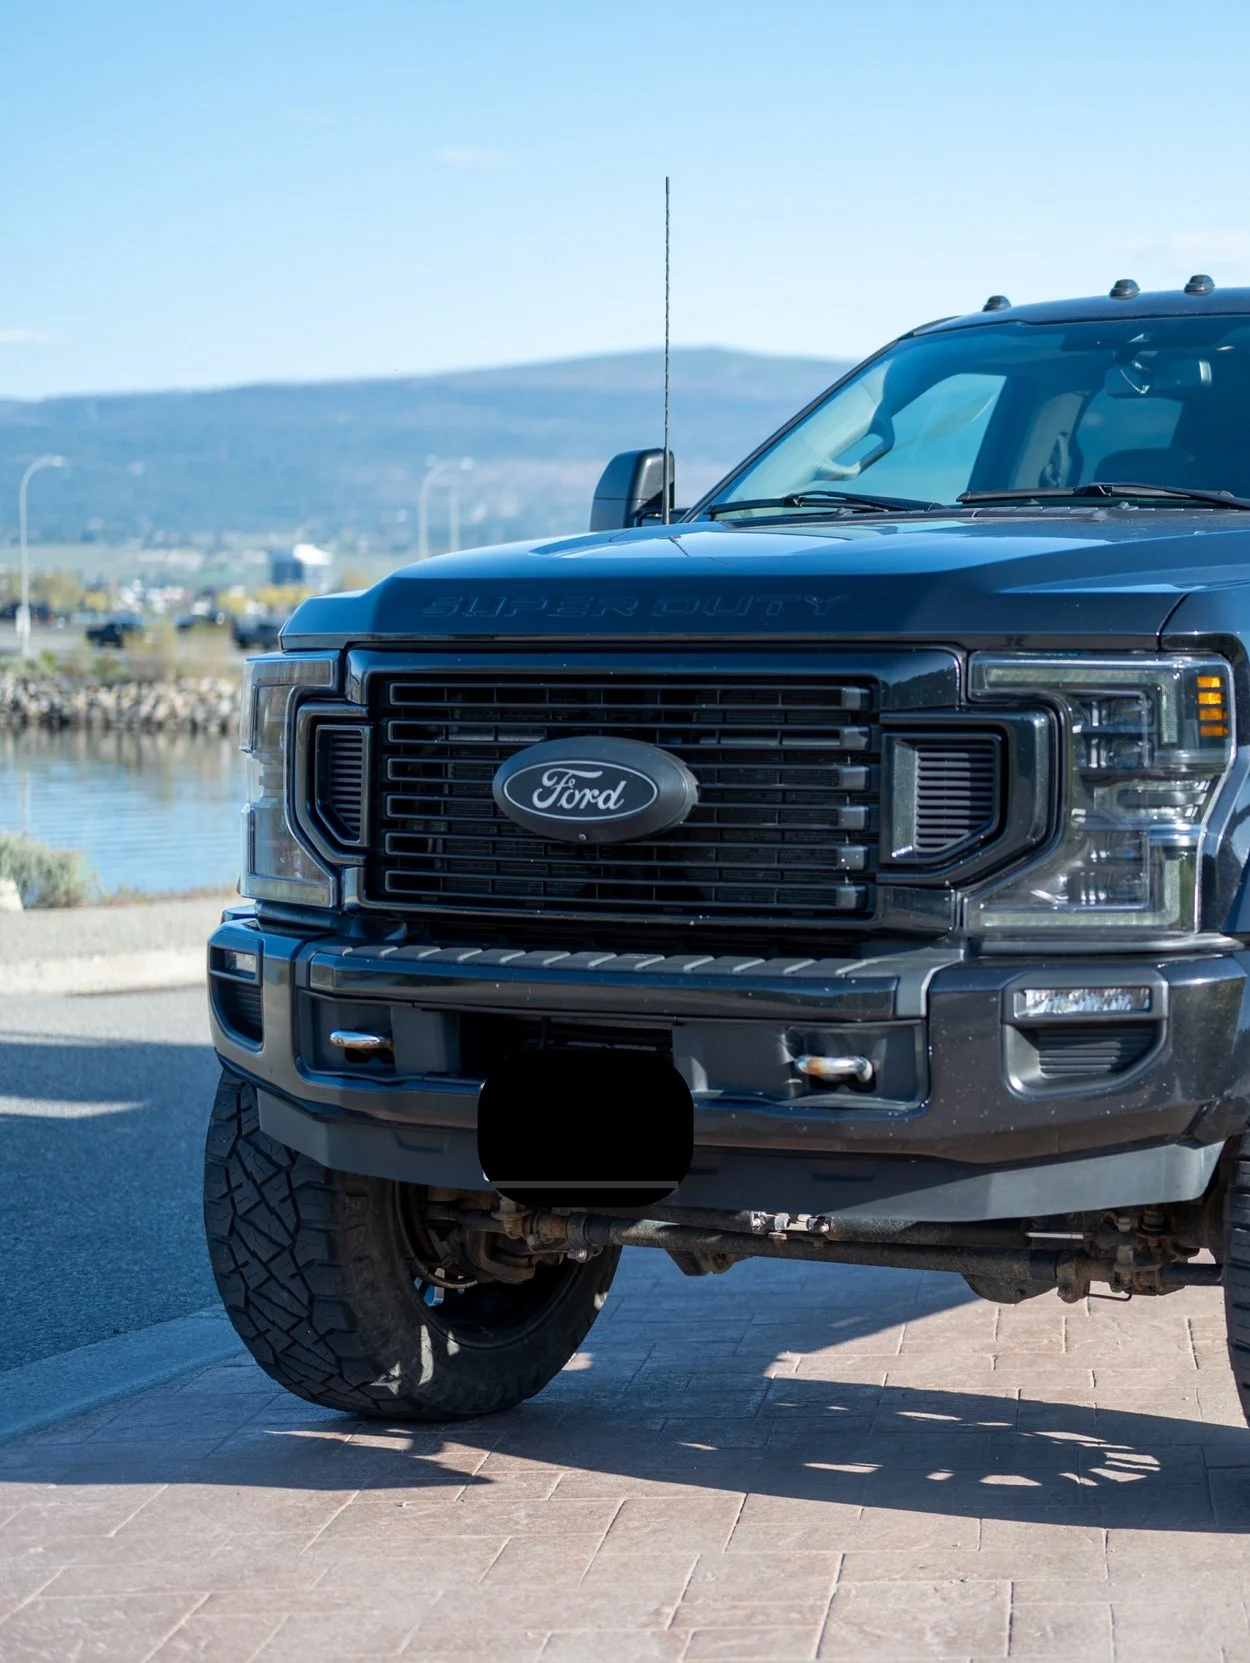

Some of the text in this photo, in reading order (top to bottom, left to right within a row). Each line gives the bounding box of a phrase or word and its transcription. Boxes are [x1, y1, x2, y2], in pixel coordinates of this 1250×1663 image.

[419, 593, 850, 618] SUPER DUTY
[532, 767, 627, 810] Ford
